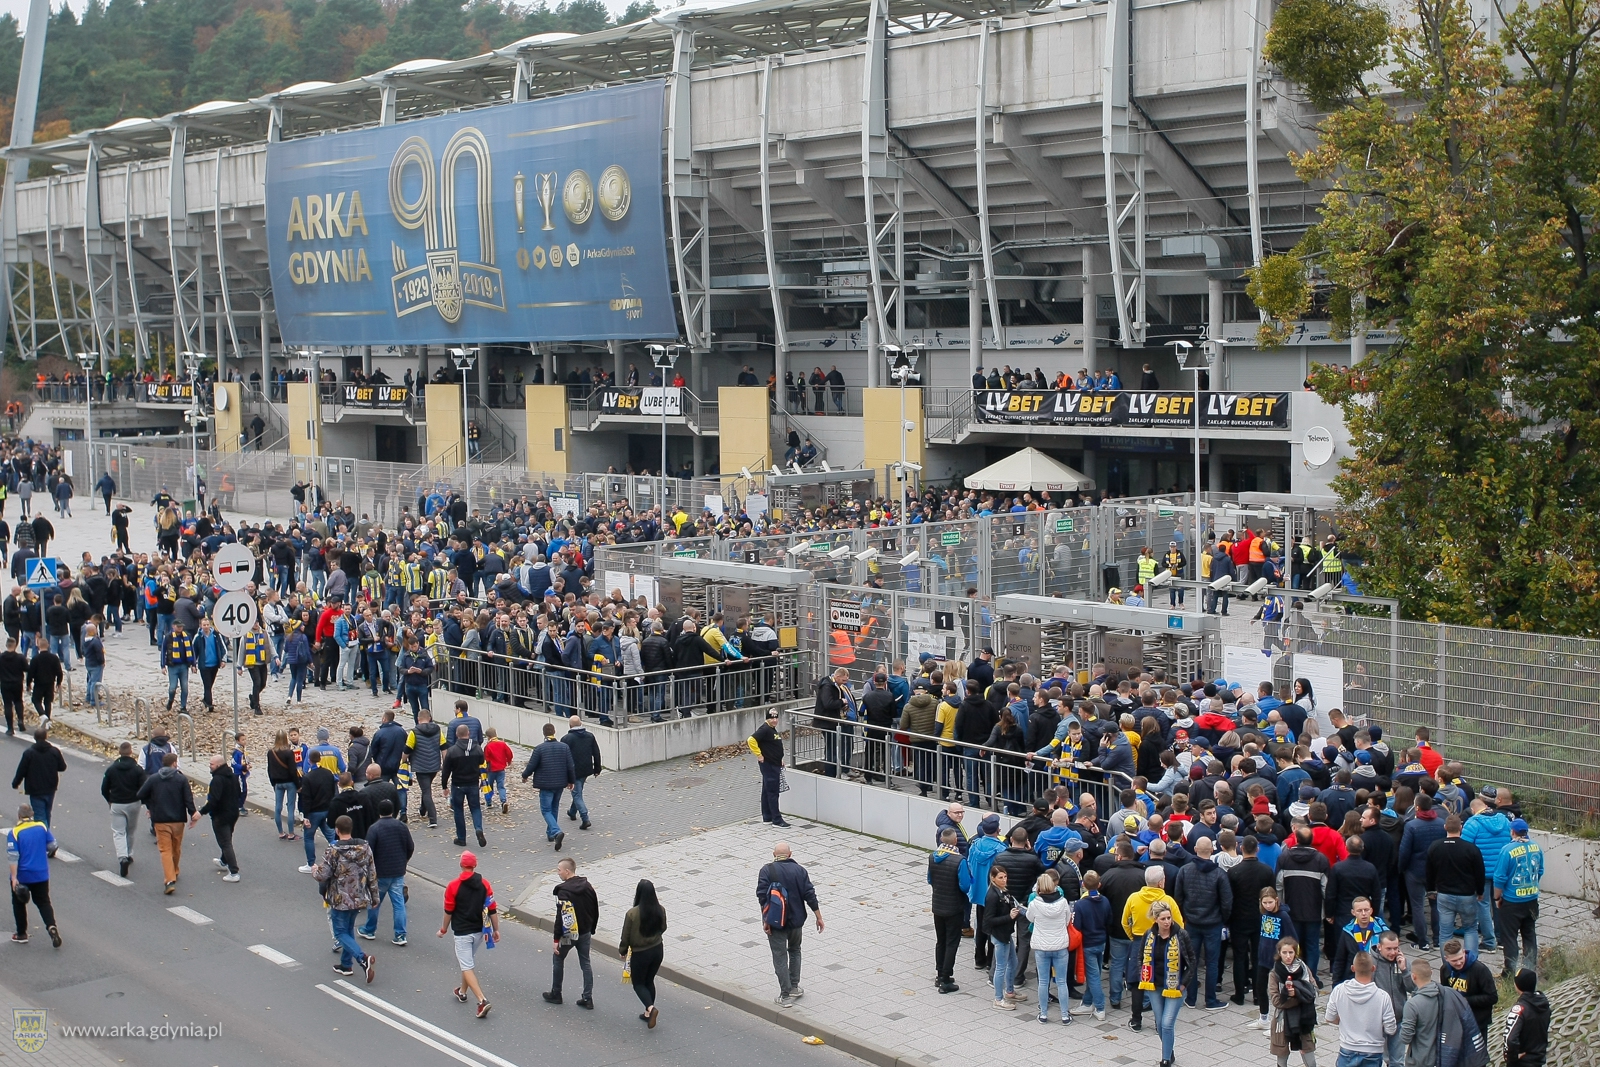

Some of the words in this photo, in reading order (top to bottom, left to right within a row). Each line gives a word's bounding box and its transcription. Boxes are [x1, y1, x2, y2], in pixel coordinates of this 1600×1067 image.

[287, 190, 369, 241] ARKA
[288, 247, 373, 285] GDYNIA
[402, 276, 429, 303] 1929
[463, 272, 494, 299] 2019
[437, 290, 459, 298] ARKA
[609, 298, 643, 311] GDYNIA
[147, 383, 169, 397] LVBET
[346, 385, 373, 400] LVBET
[378, 386, 407, 401] LVBET
[602, 391, 639, 409] LVBET
[985, 392, 1044, 412] LVBET
[1053, 392, 1116, 413] LVBET
[1128, 393, 1194, 415] LVBET
[1207, 394, 1277, 416] LVBET
[1307, 434, 1330, 442] Televes
[1128, 518, 1134, 528] 6
[1016, 526, 1021, 535] 5
[629, 560, 635, 569] 2
[749, 552, 756, 563] 3
[221, 602, 250, 626] 40
[839, 610, 860, 620] NORD
[941, 615, 946, 628] 1
[1009, 643, 1032, 652] SEKTOR
[1108, 655, 1133, 665] SEKTOR
